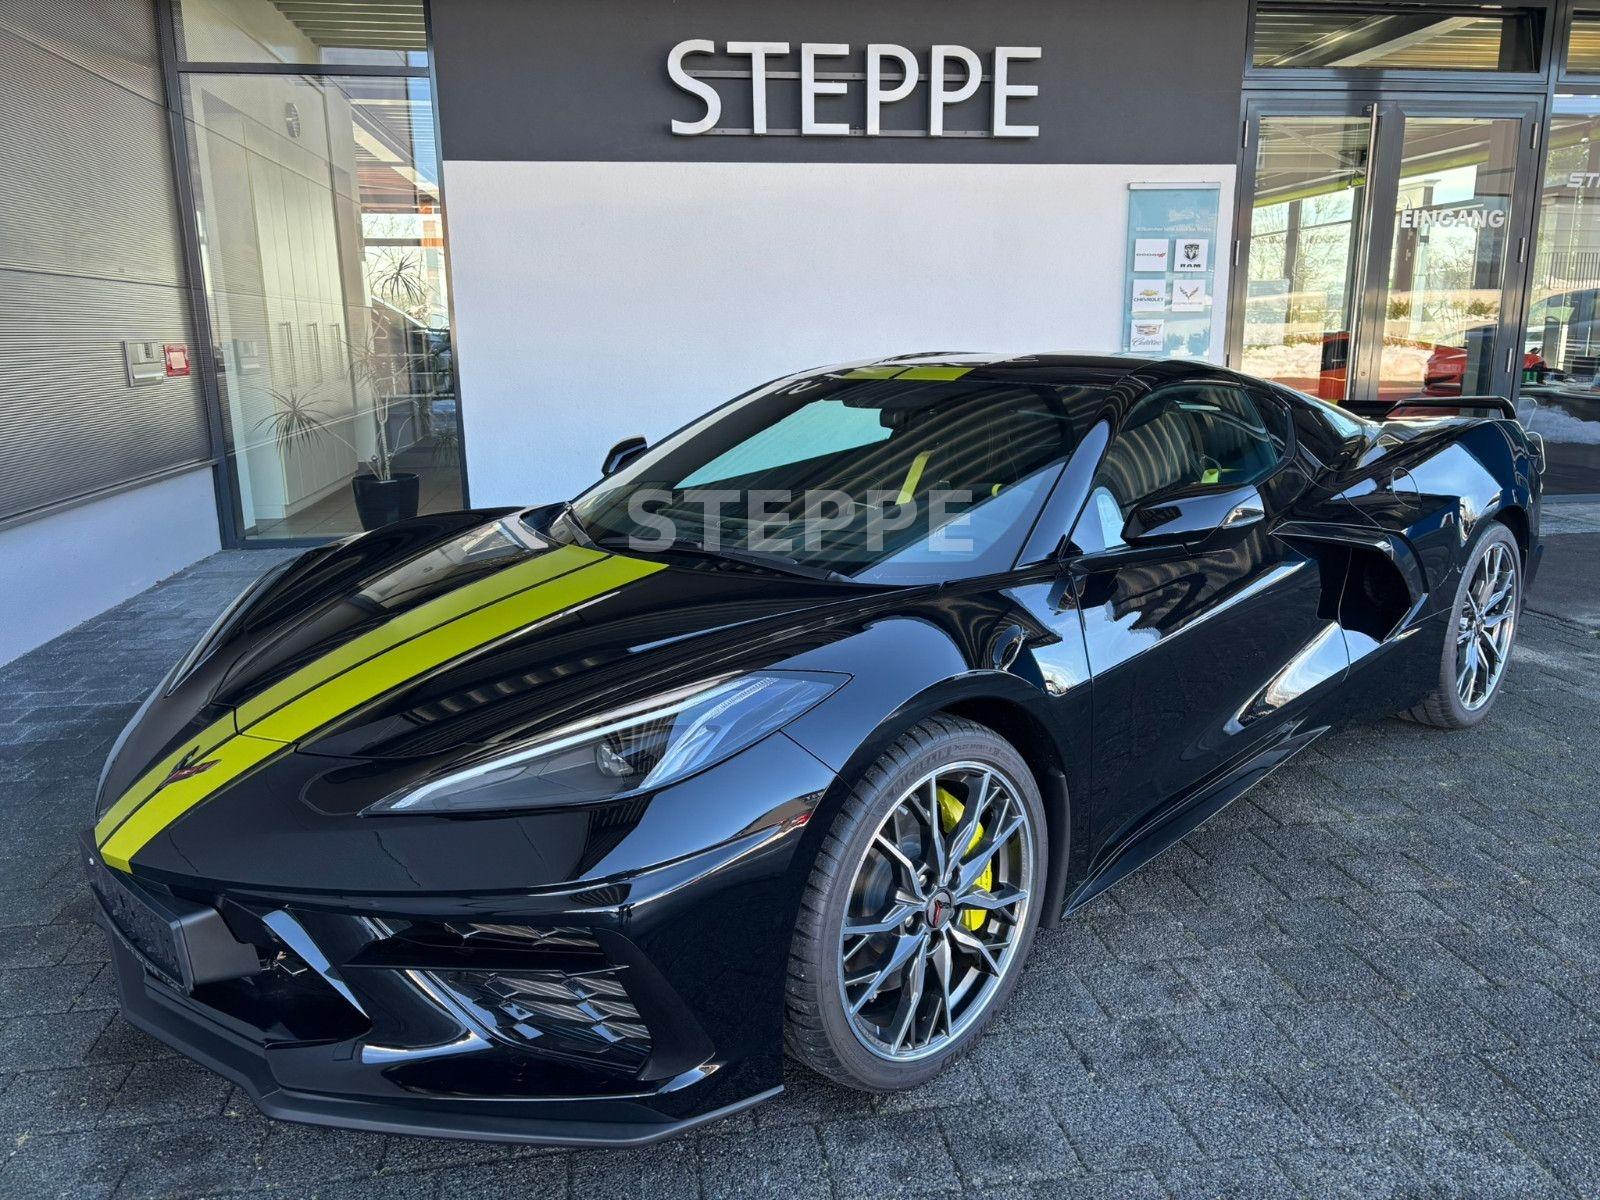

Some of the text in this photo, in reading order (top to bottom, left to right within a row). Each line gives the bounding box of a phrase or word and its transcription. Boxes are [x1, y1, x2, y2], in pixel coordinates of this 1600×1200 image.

[667, 38, 1042, 137] STEPPE
[1567, 172, 1600, 188] ST
[1400, 209, 1505, 229] EINGANG
